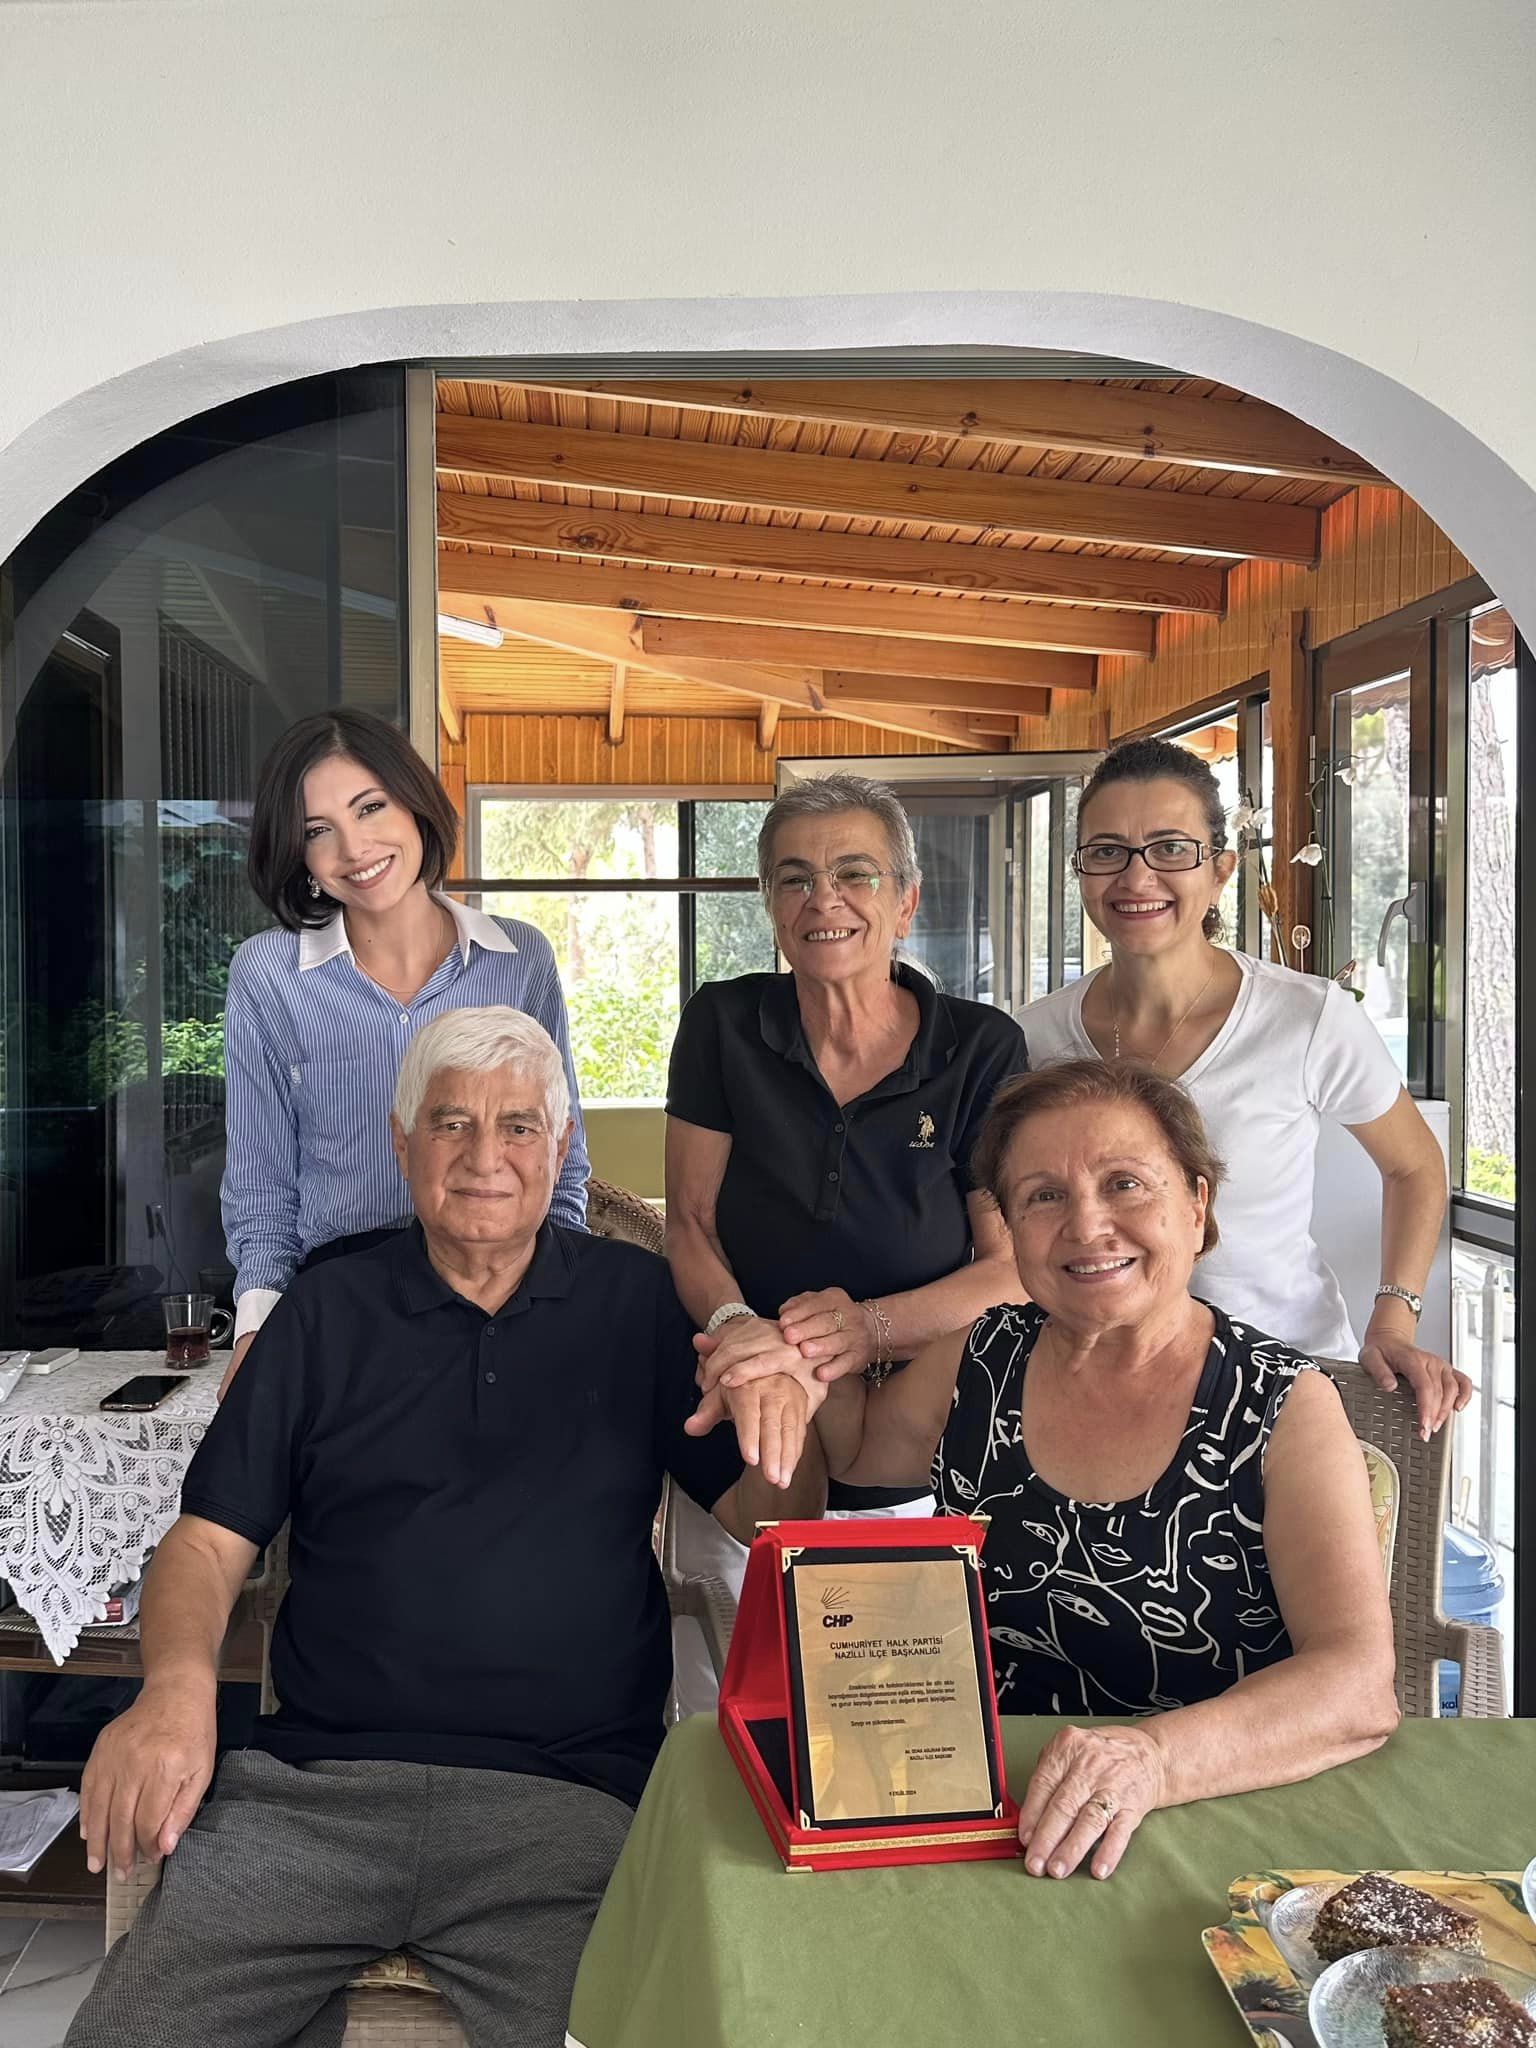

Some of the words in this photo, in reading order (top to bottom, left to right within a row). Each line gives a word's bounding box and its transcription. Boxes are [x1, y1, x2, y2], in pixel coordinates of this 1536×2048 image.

[822, 1614, 854, 1628] CHP
[830, 1639, 882, 1650] CUMHURİYET
[886, 1639, 909, 1648] HALK
[912, 1635, 943, 1646] PARTİSİ
[869, 1648, 888, 1659] İLÇE
[891, 1646, 941, 1658] BAŞKANLIĞI
